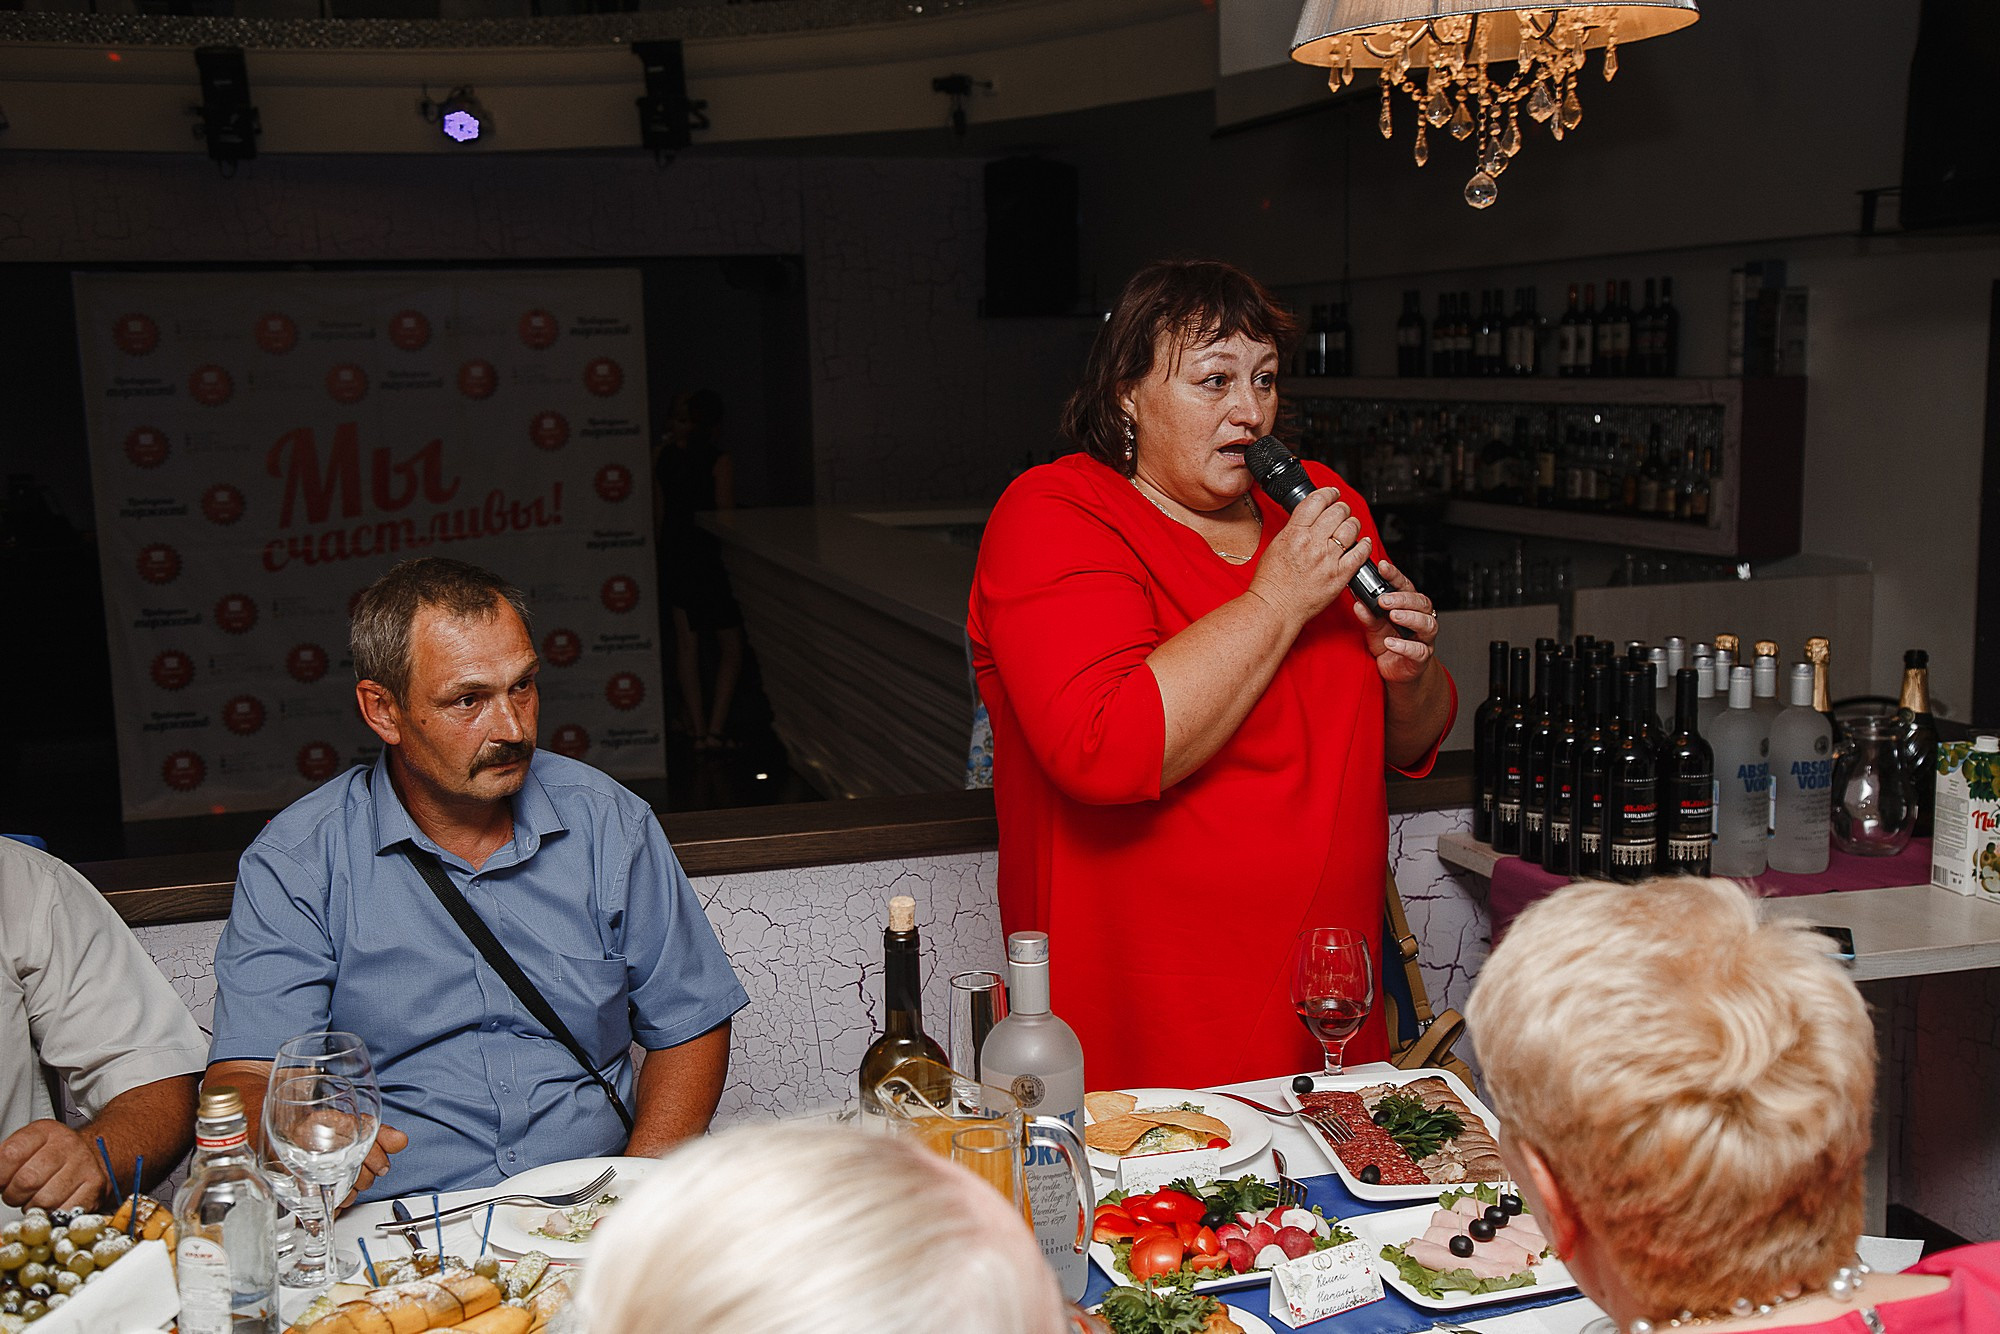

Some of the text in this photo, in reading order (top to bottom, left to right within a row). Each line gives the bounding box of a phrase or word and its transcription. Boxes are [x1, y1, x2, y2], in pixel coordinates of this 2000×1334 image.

[266, 421, 462, 529] Мы
[261, 482, 565, 573] счастливы!
[1737, 762, 1769, 778] ABSO
[1790, 759, 1832, 776] ABSOL
[1744, 778, 1768, 793] VOD
[1797, 774, 1831, 790] VODK
[1024, 1145, 1066, 1167] DKA
